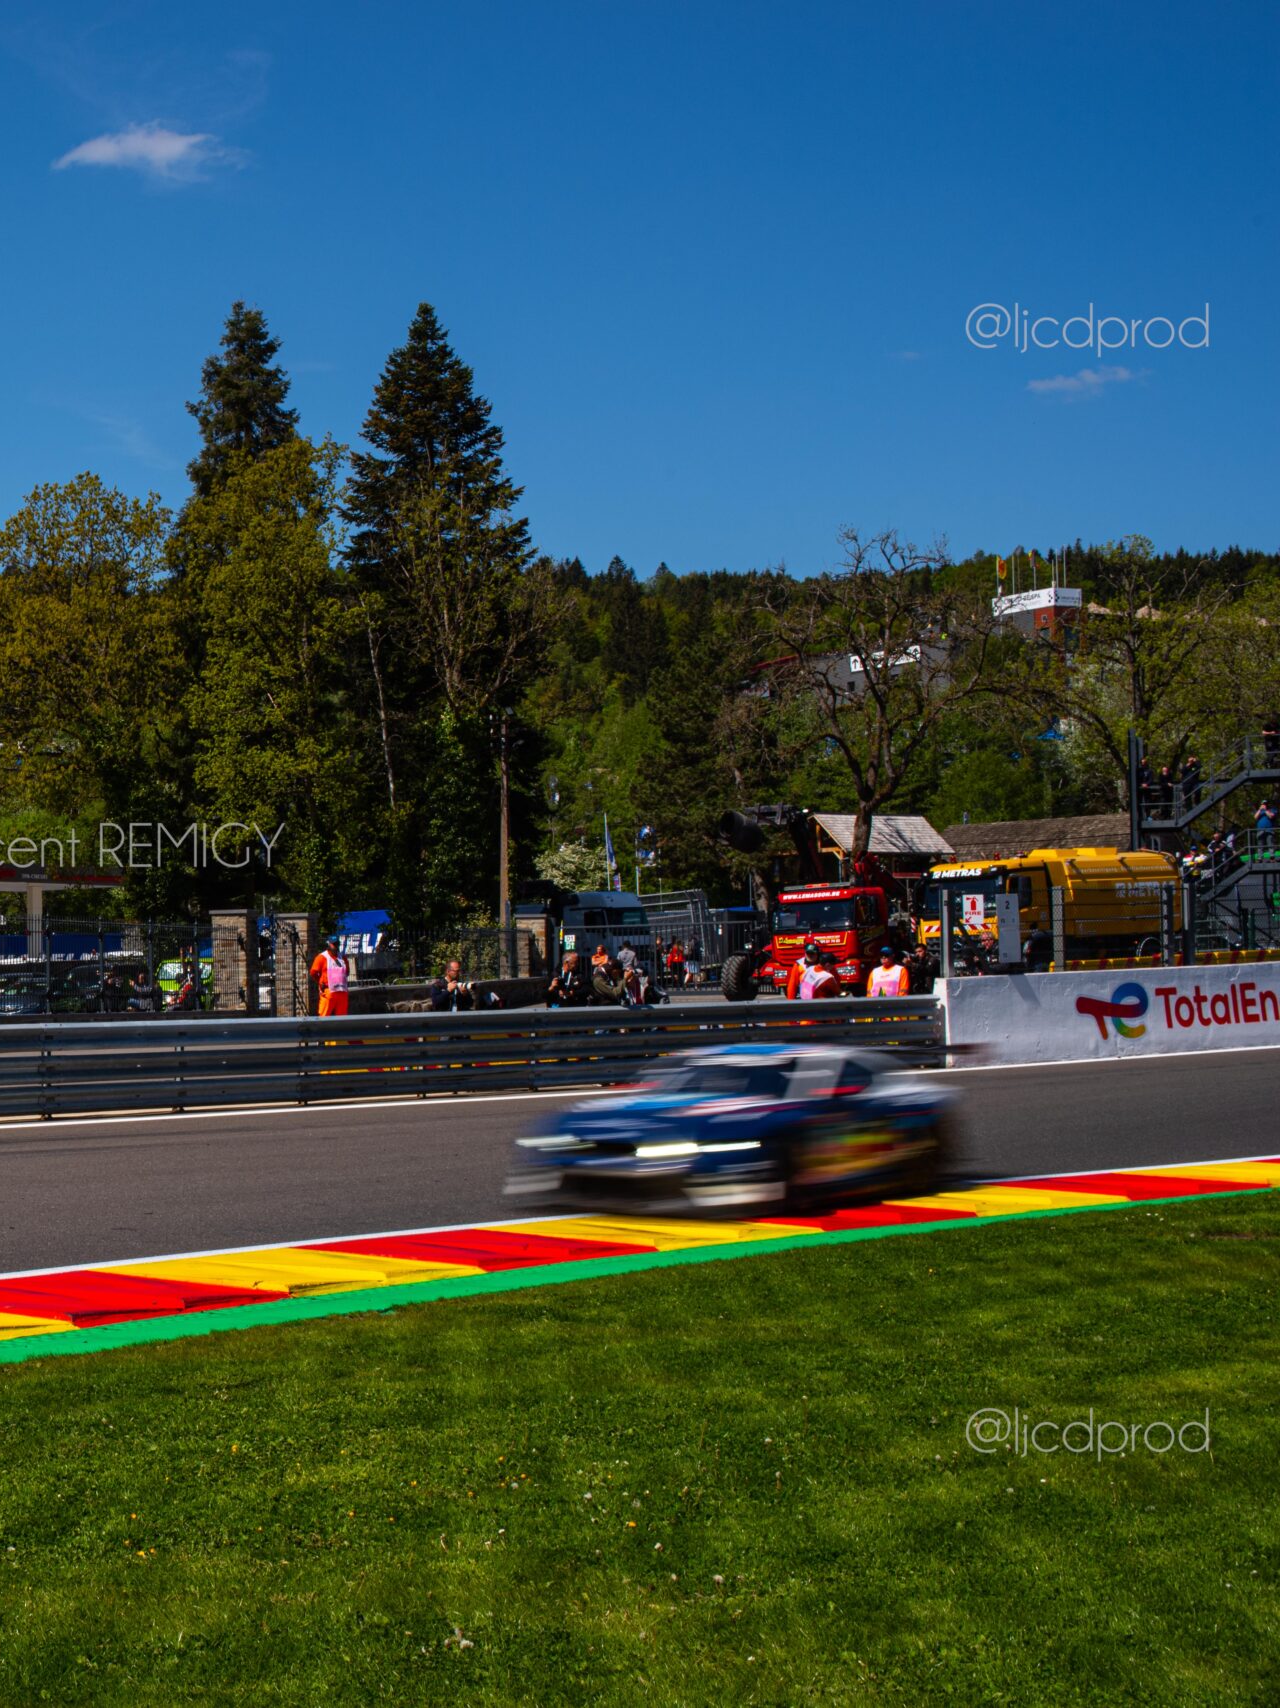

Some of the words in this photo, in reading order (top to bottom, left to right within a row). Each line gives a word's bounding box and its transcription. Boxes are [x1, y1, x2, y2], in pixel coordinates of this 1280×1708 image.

[941, 868, 982, 879] METRAS
[782, 891, 841, 901] WWW.LEMASSON.BE
[1005, 901, 1010, 910] 2
[1155, 982, 1280, 1029] TotalEn
